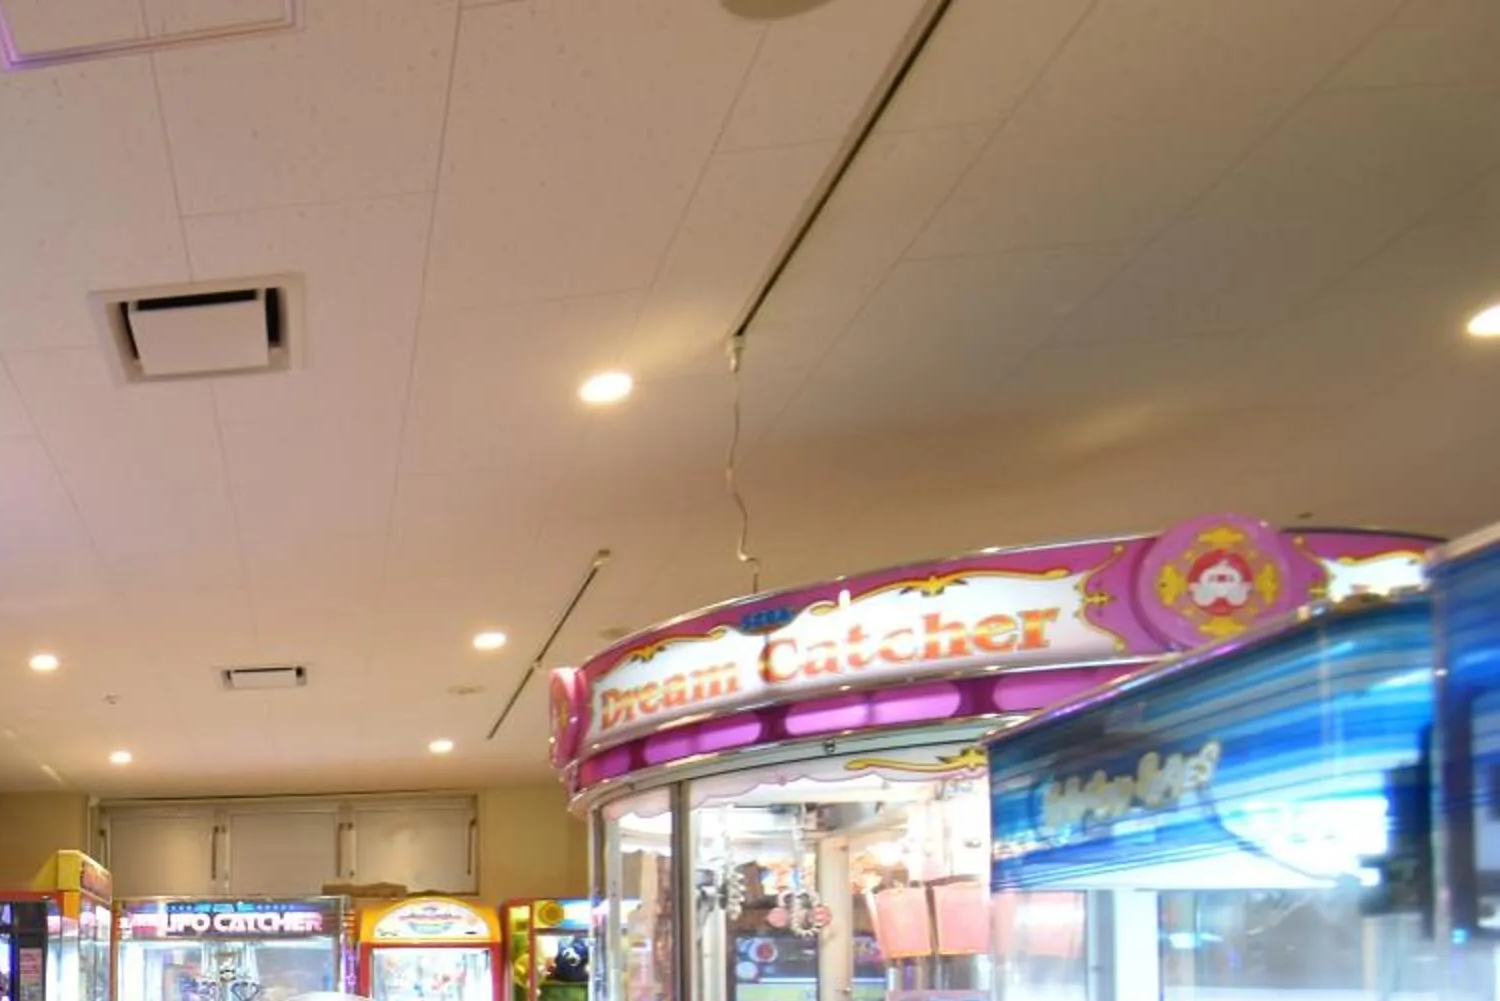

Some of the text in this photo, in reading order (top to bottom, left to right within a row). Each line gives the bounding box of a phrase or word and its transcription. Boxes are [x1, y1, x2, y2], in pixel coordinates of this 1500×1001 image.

[601, 607, 1061, 731] Dream Catcher
[161, 911, 323, 933] UFO CATCHER
